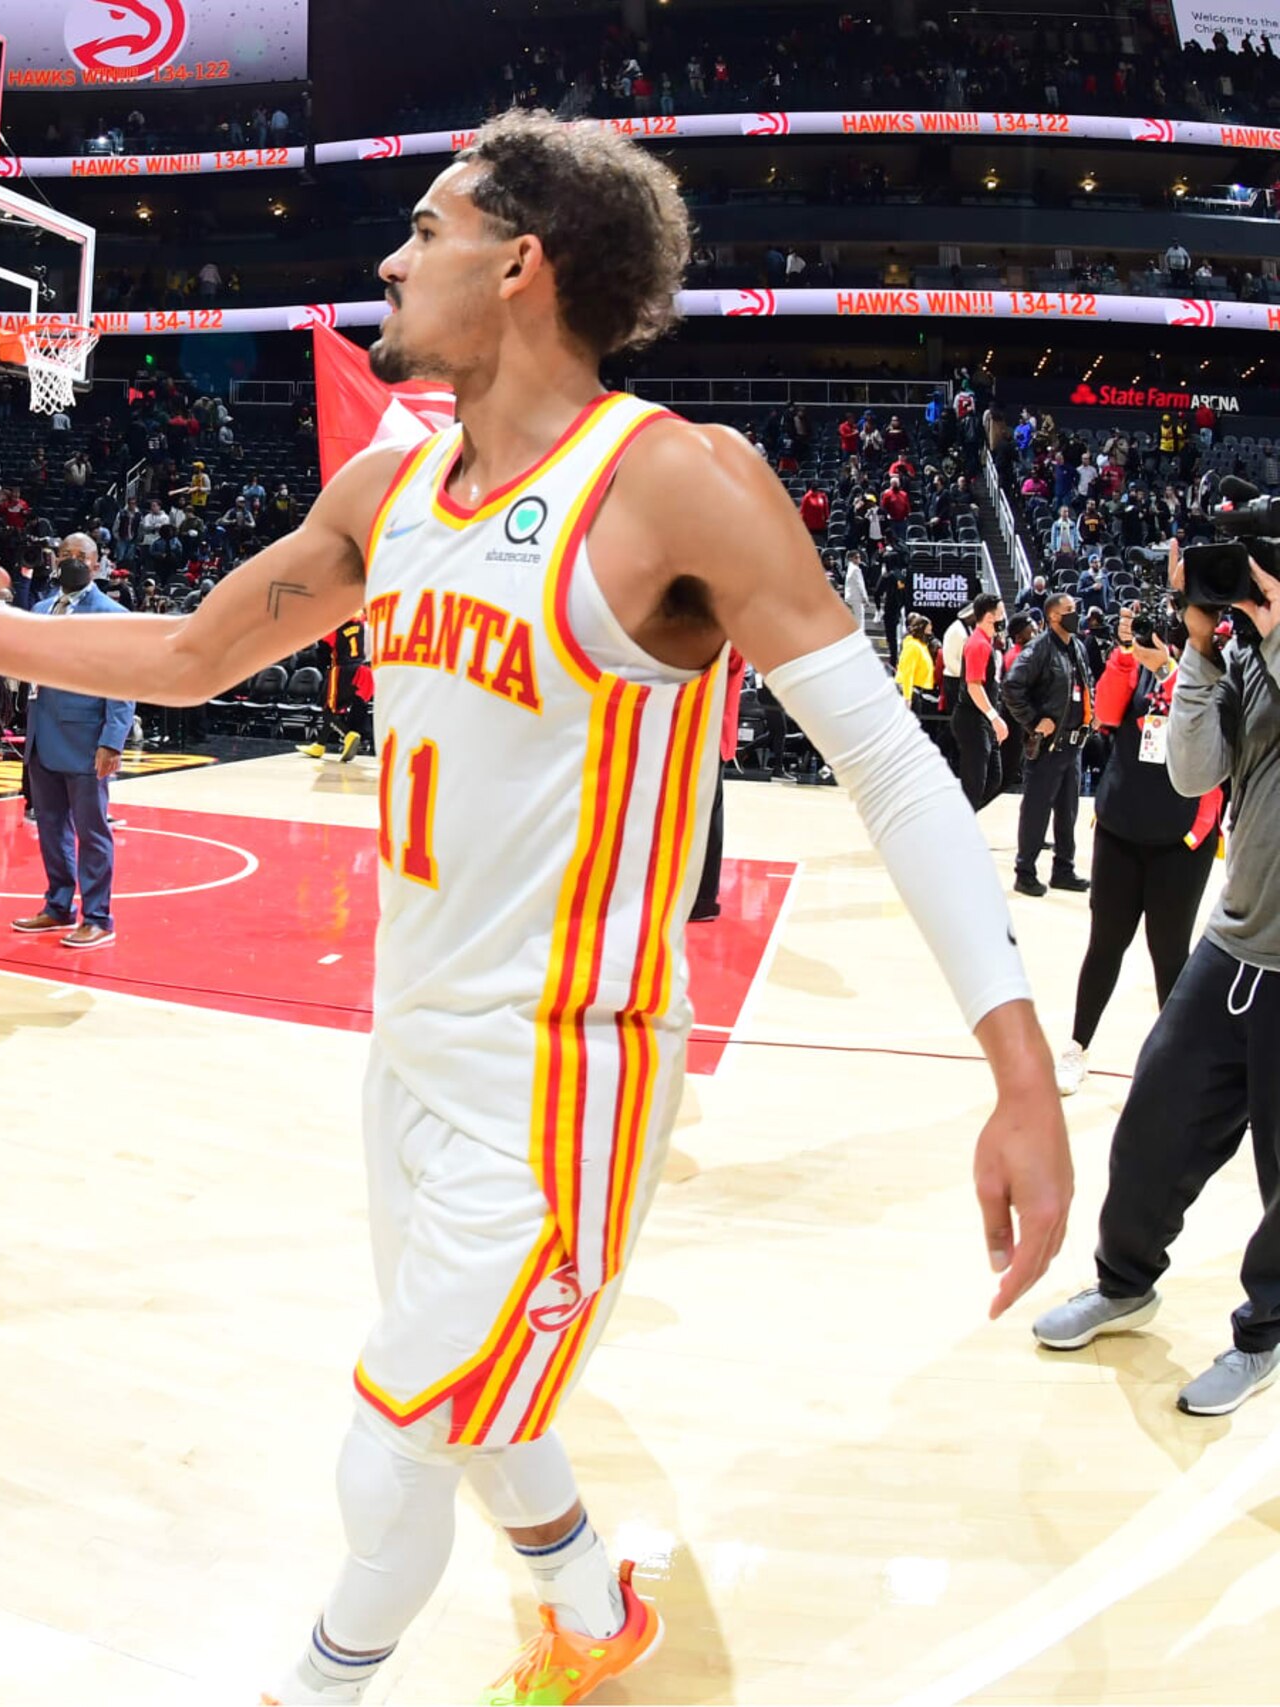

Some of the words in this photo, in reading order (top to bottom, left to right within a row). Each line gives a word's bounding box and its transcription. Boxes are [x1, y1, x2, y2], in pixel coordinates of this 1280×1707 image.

[7, 69, 76, 88] HAWKS
[82, 66, 139, 85] WIN!!!
[152, 60, 230, 83] 134-122
[842, 113, 916, 133] HAWKS
[920, 113, 980, 132] WIN!!!
[993, 114, 1070, 133] 134-122
[71, 157, 140, 177] HAWKS
[146, 154, 201, 175] WIN!!!
[214, 148, 289, 169] 134-122
[836, 292, 920, 316] HAWKS
[926, 292, 994, 315] WIN!!!
[1009, 292, 1098, 316] 134-122
[144, 309, 223, 332] 134-122
[1099, 385, 1144, 407] State
[1147, 387, 1191, 410] Farm
[912, 590, 969, 602] CHEROKEE
[368, 588, 543, 717] TLANTA
[377, 727, 440, 891] 11
